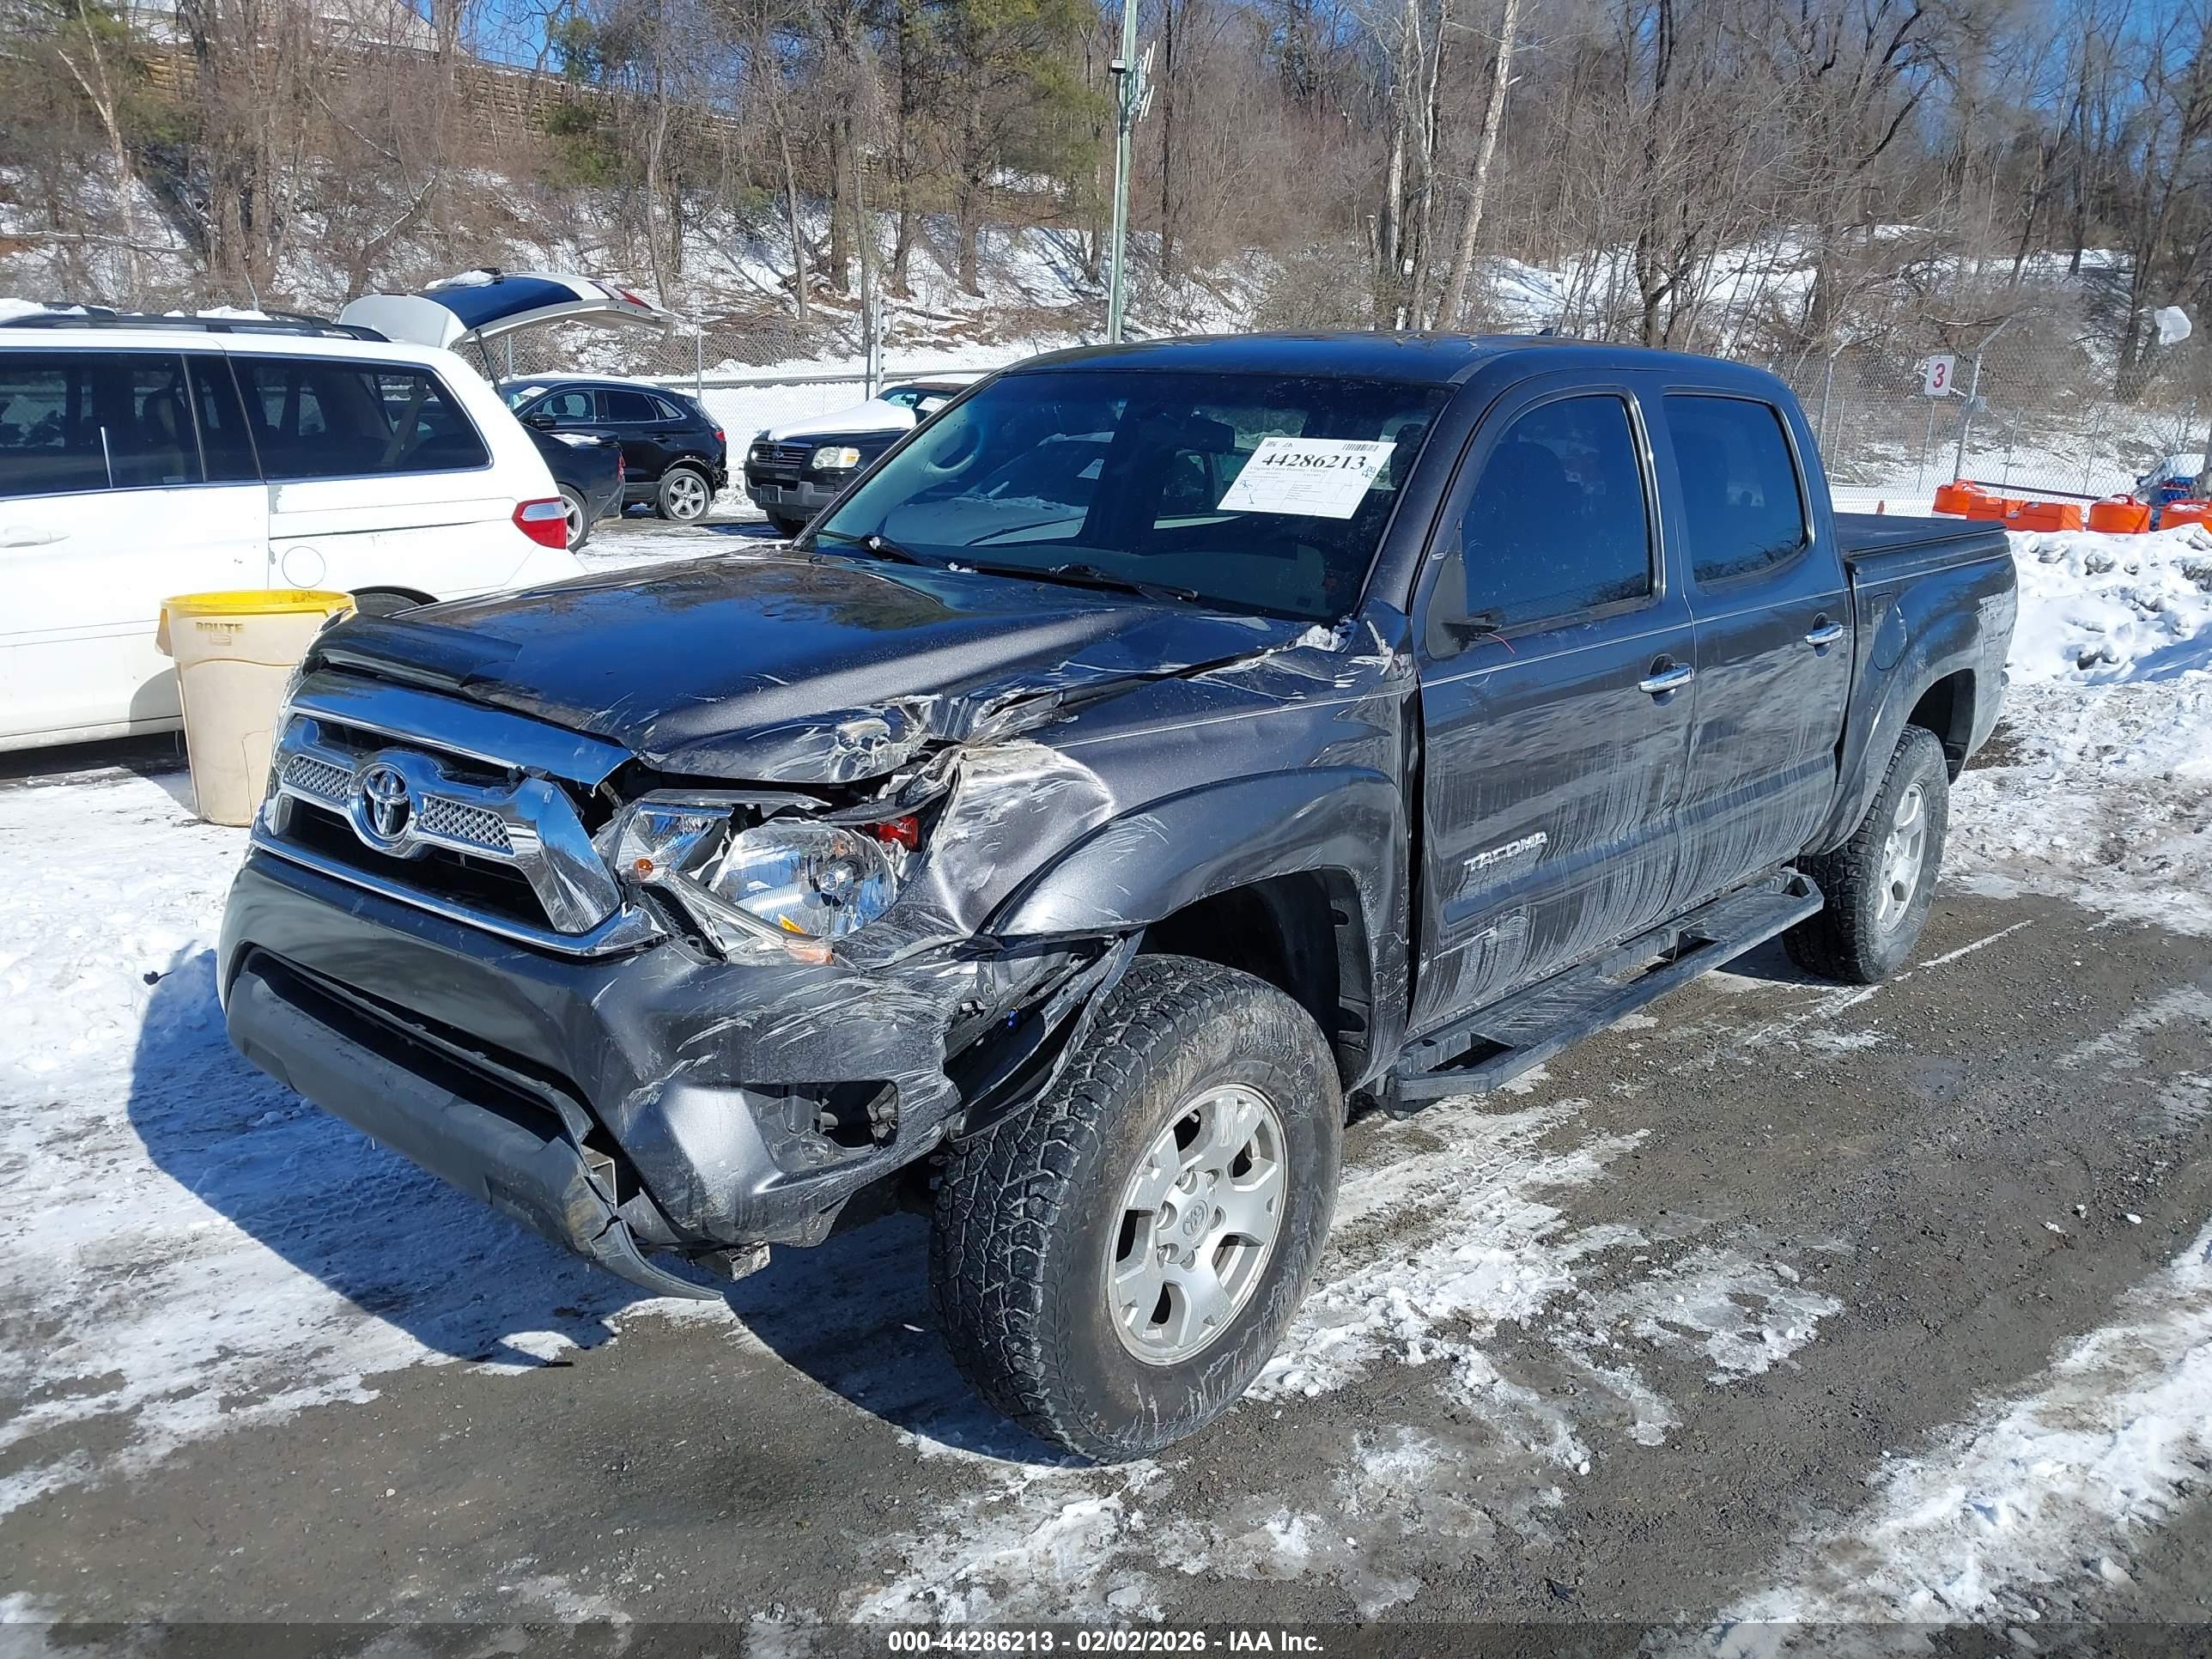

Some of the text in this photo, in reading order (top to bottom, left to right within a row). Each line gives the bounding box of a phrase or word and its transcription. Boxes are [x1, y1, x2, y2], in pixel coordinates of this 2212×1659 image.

[1932, 362, 1946, 388] 3
[1261, 453, 1367, 470] 44286213
[196, 622, 244, 633] BRUTE
[1463, 831, 1548, 872] TACOMA
